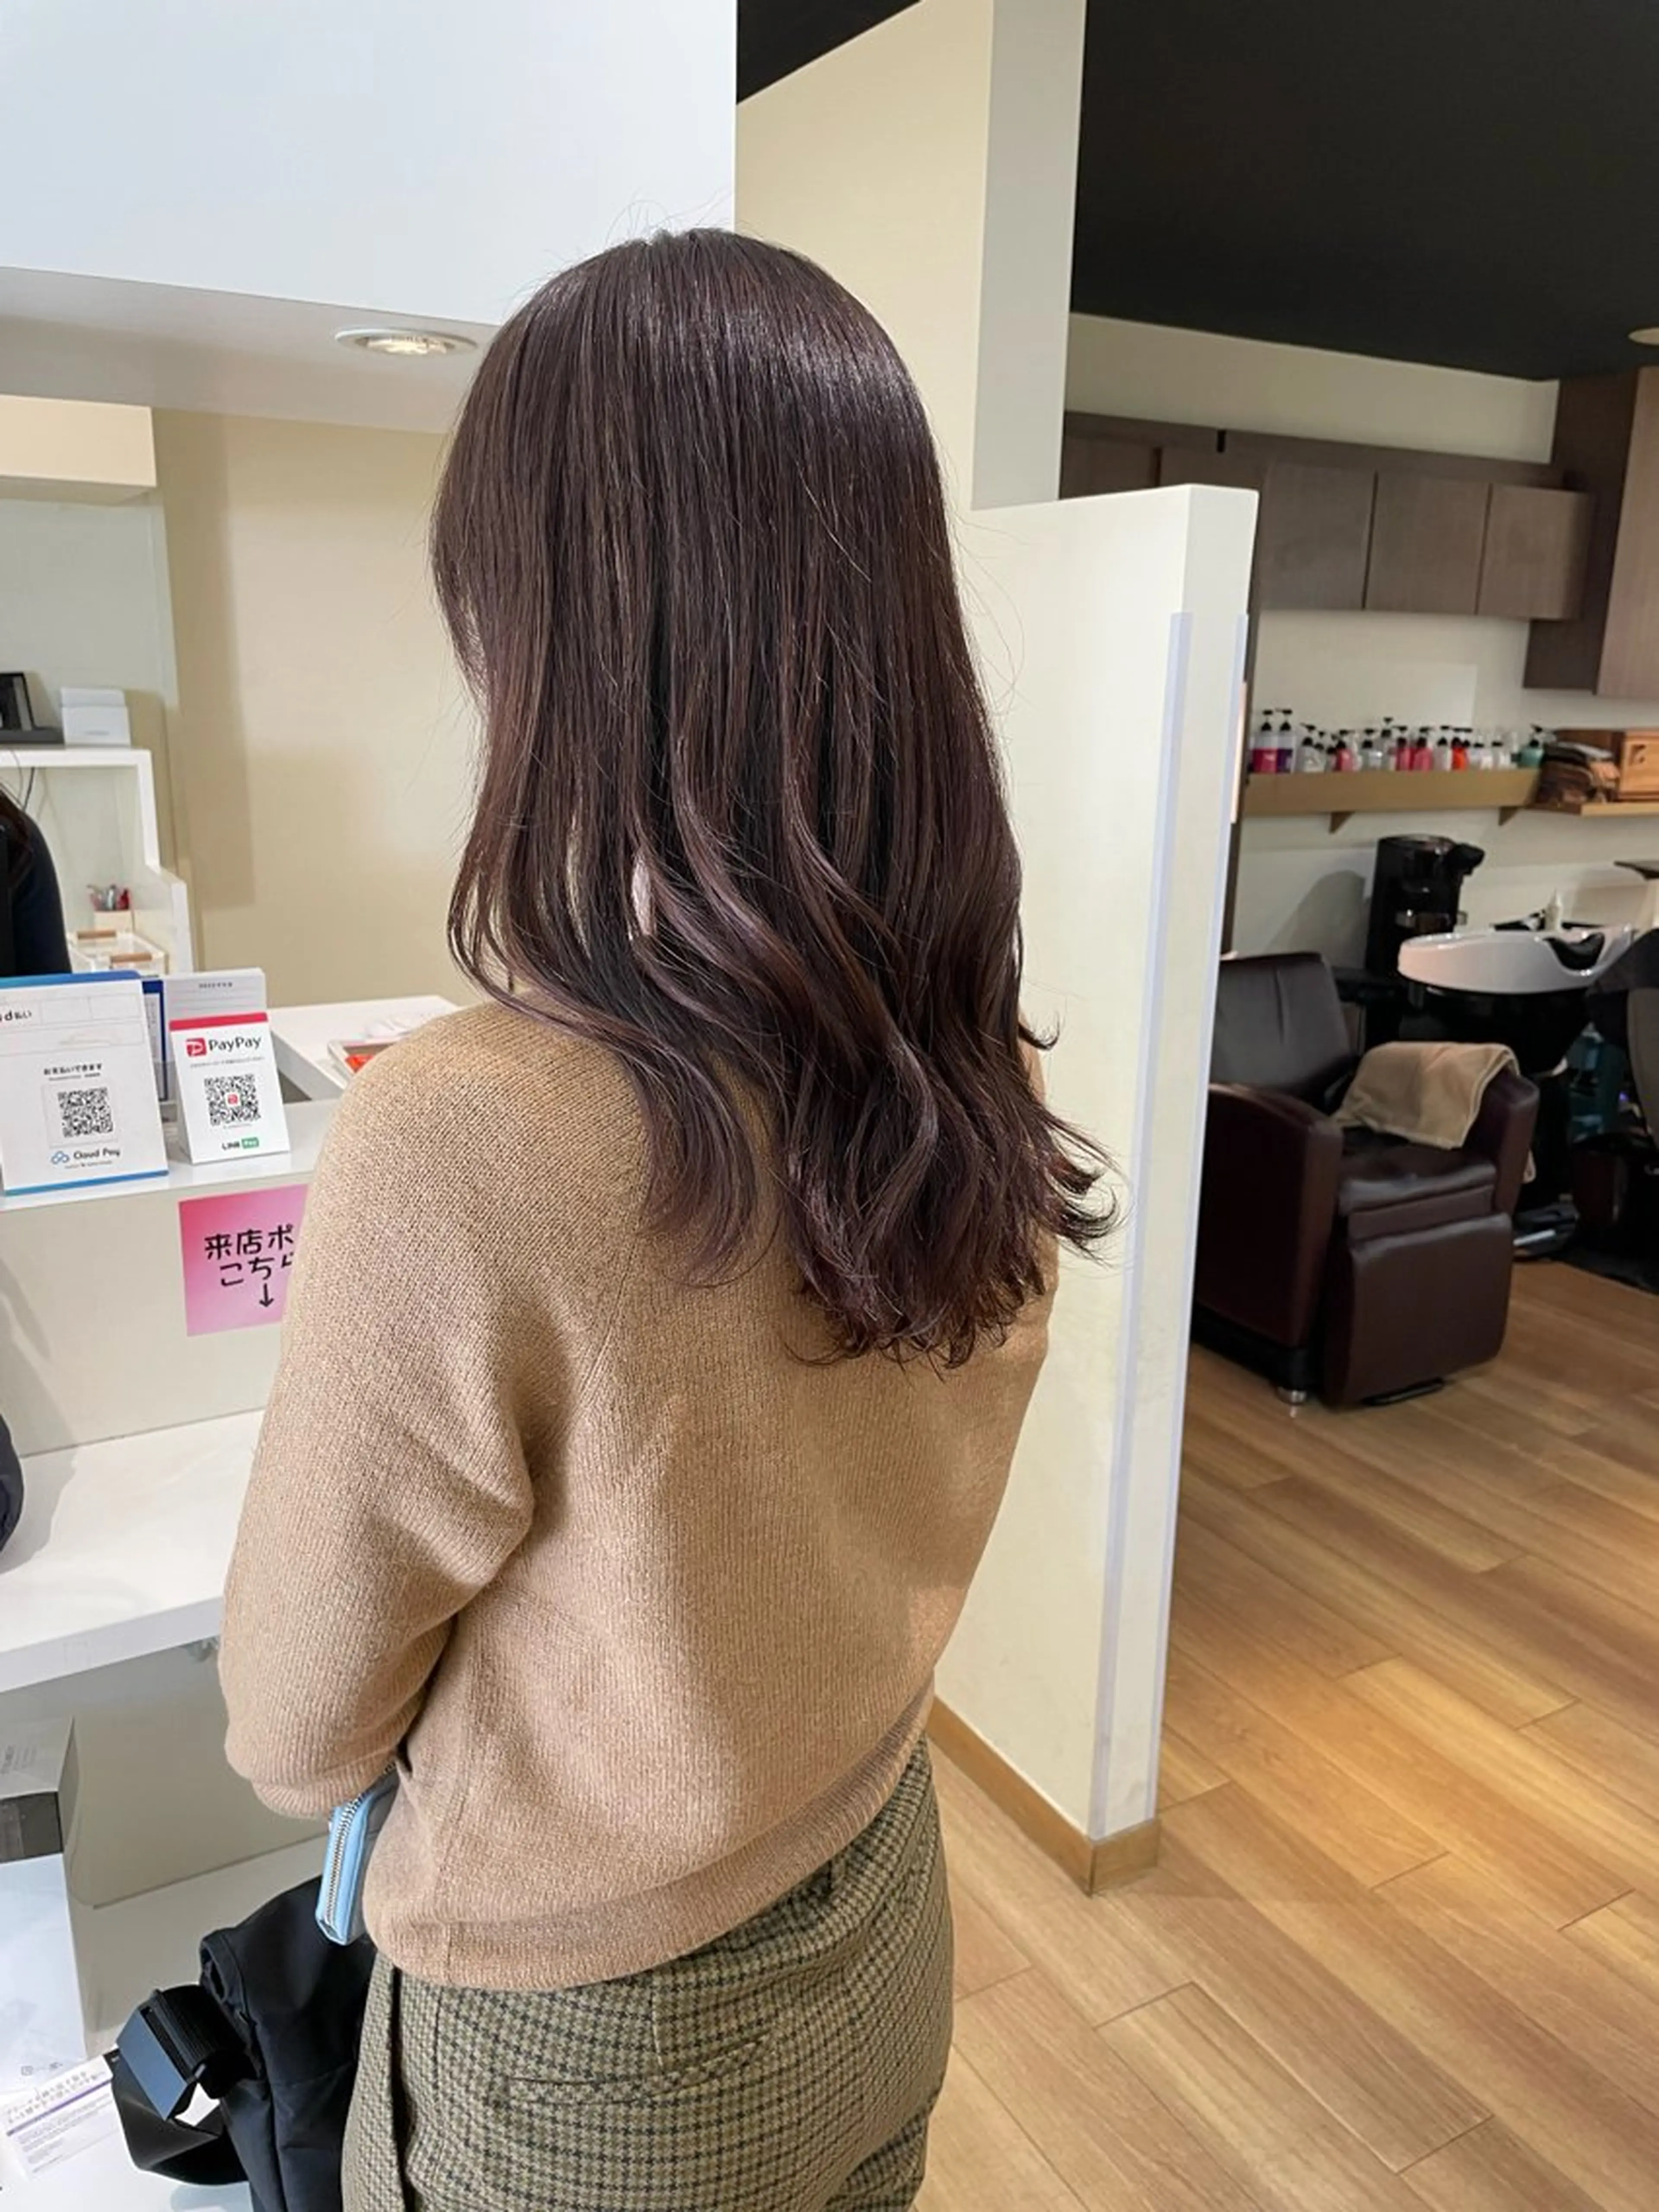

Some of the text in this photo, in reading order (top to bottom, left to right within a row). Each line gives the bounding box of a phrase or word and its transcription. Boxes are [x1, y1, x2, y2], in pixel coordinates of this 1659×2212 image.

[208, 1036, 261, 1052] PayPay
[74, 1147, 120, 1159] Cloud Pay
[204, 1224, 293, 1260] 来店ポ
